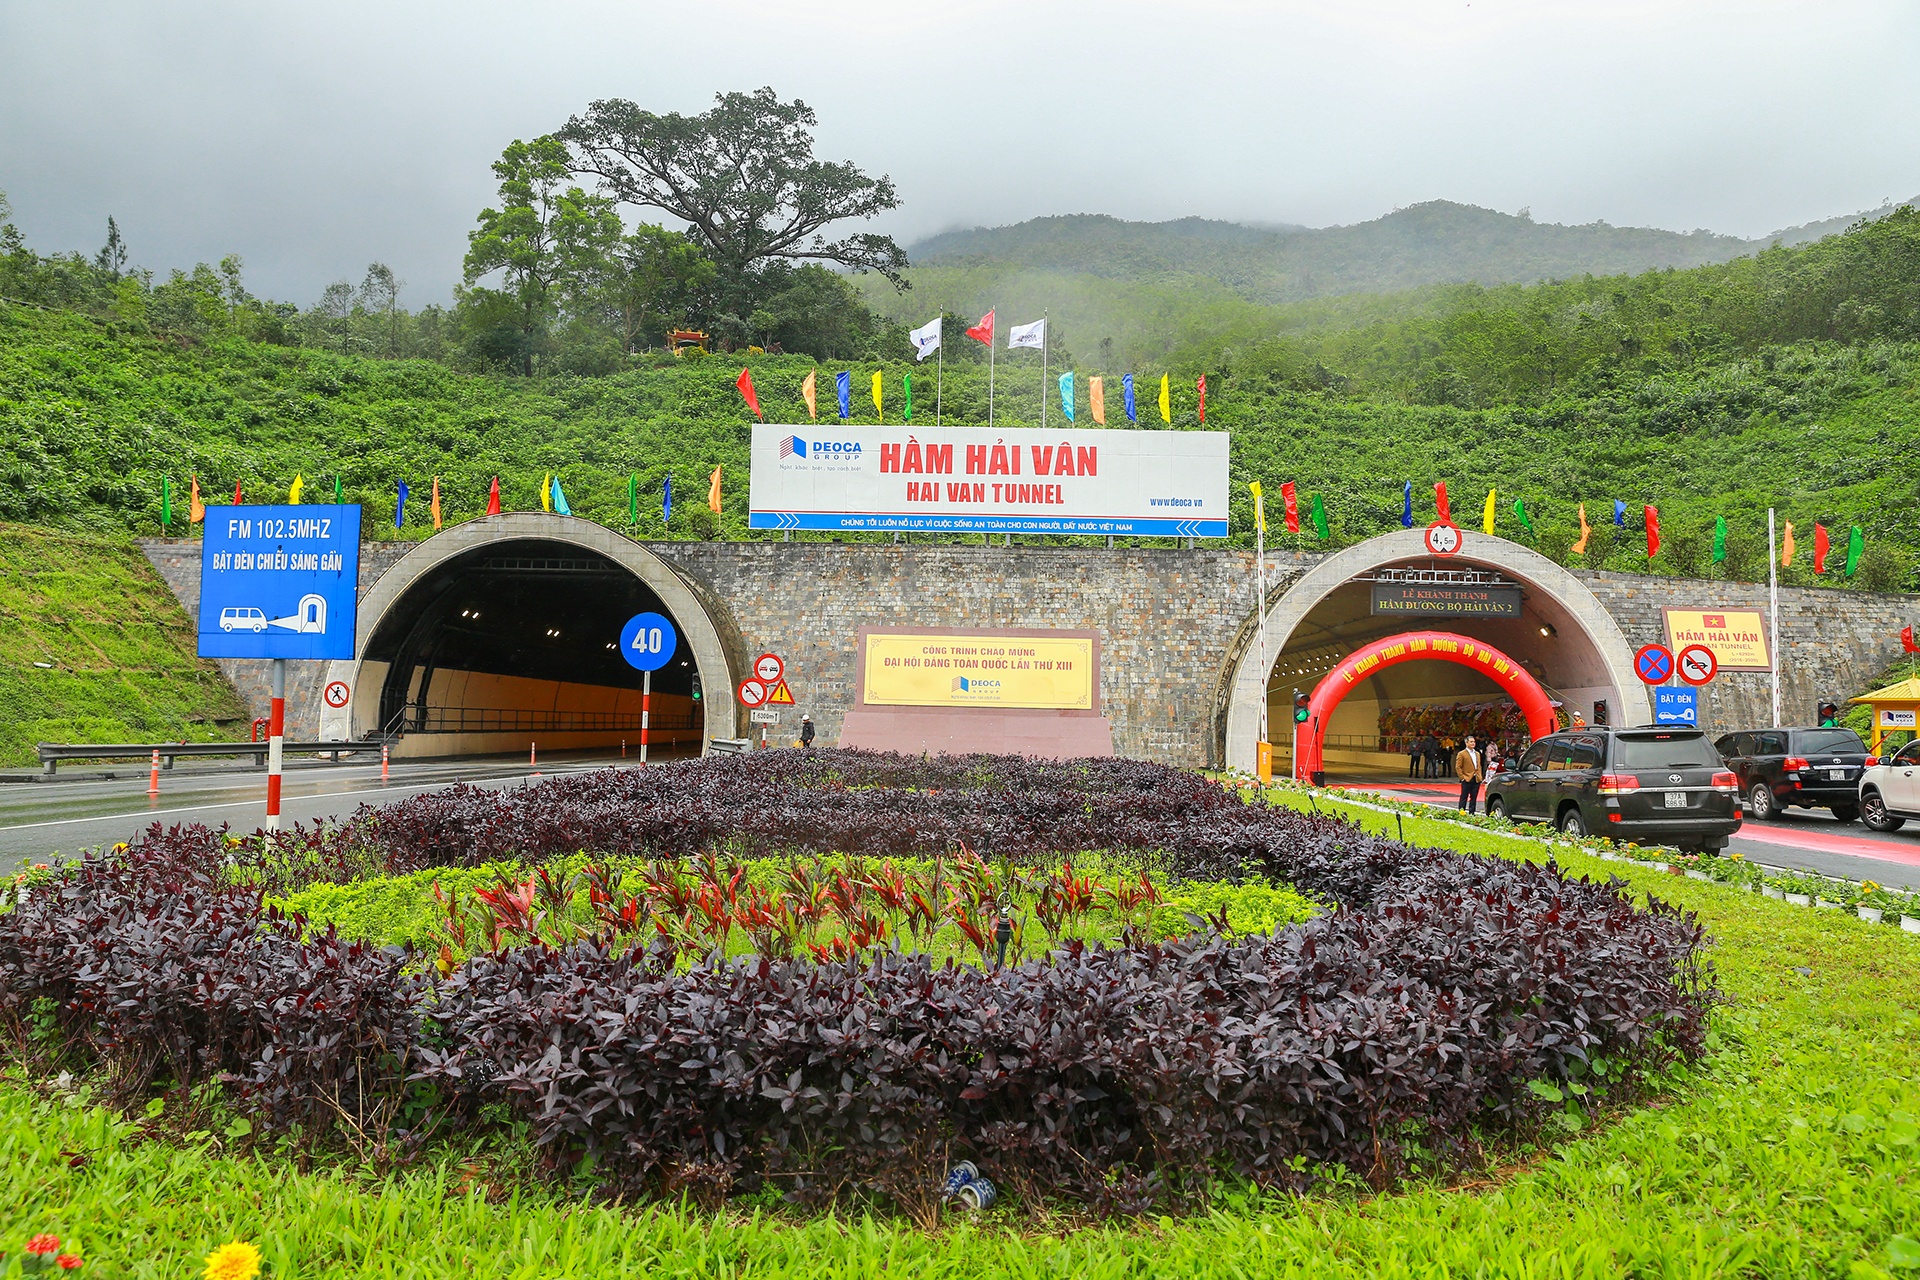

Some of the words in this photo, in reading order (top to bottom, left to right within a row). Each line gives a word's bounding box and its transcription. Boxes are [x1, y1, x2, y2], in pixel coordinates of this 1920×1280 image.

[813, 442, 862, 452] DEOCA
[880, 435, 953, 474] HẦM
[966, 438, 1021, 475] HẢI
[1031, 441, 1097, 476] VÂN
[907, 482, 939, 502] HAI
[947, 483, 985, 503] VAN
[992, 484, 1064, 504] TUNNEL
[228, 519, 252, 539] FM
[257, 519, 331, 539] 102.5MHZ
[841, 518, 865, 526] CHÚNG
[867, 518, 877, 526] TÔI
[878, 518, 897, 526] LUÔN
[934, 519, 952, 528] CUỘC
[987, 520, 1006, 528] TOÀN
[1099, 522, 1114, 531] VIỆT
[212, 549, 232, 573] BẬT
[234, 549, 254, 570] ĐÈN
[290, 550, 318, 571] SÁNG
[321, 550, 342, 571] GẦN
[1447, 601, 1462, 612] BỘ
[1464, 601, 1482, 611] HẢI
[1484, 601, 1504, 611] VÂN
[1507, 604, 1512, 612] 2
[631, 627, 662, 654] 40
[1709, 630, 1730, 641] HẢI
[1733, 631, 1759, 642] VÂN
[922, 645, 947, 655] CÔNG
[951, 646, 977, 655] TRÌNH
[1009, 647, 1035, 656] MỪNG
[884, 657, 901, 668] ĐẠI
[904, 656, 921, 669] HỘI
[924, 656, 950, 668] ĐẢNG
[953, 657, 978, 668] TOÀN
[981, 657, 1008, 669] QUỐC
[1034, 659, 1053, 670] THỨ
[1056, 661, 1072, 670] XIII
[1463, 643, 1475, 658] BỘ
[1509, 670, 1519, 681] 2
[1661, 693, 1675, 704] BẬT
[1677, 693, 1692, 703] ĐÈN
